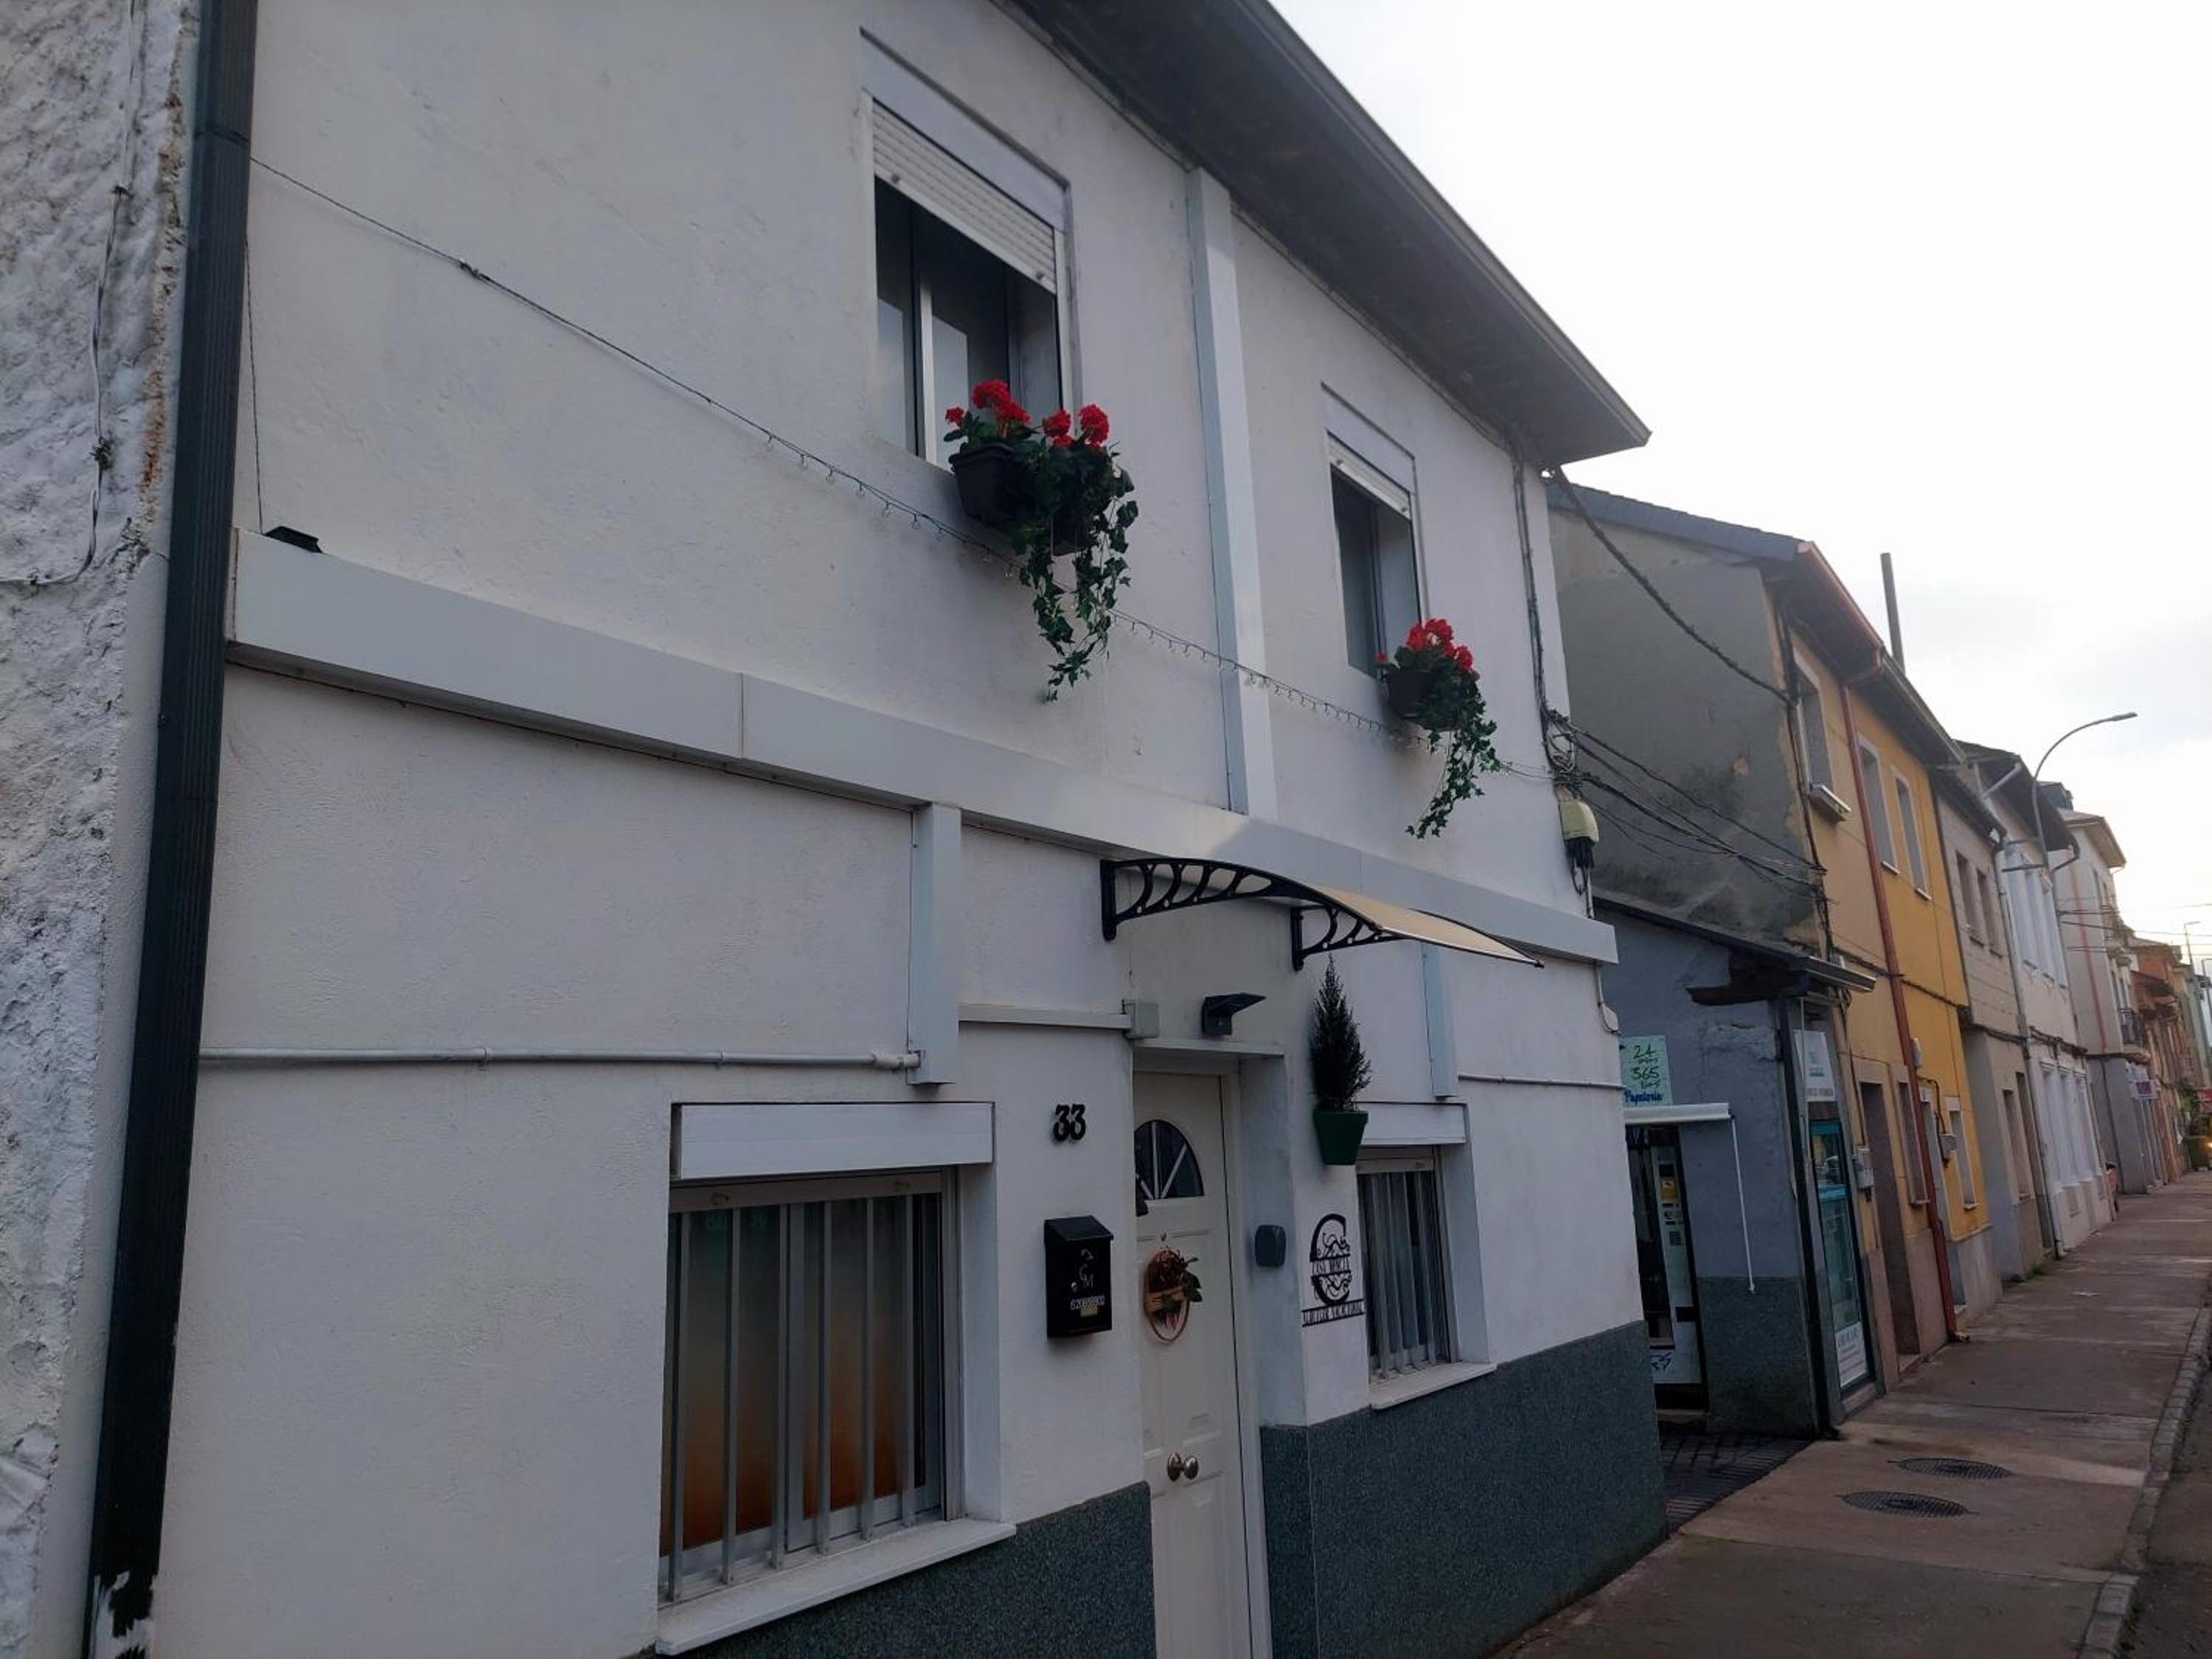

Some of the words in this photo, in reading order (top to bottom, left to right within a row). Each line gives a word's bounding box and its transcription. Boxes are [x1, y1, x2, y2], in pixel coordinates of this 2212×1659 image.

[1632, 1043, 1658, 1060] 24
[1630, 1066, 1660, 1080] 365
[1053, 1103, 1085, 1142] 33
